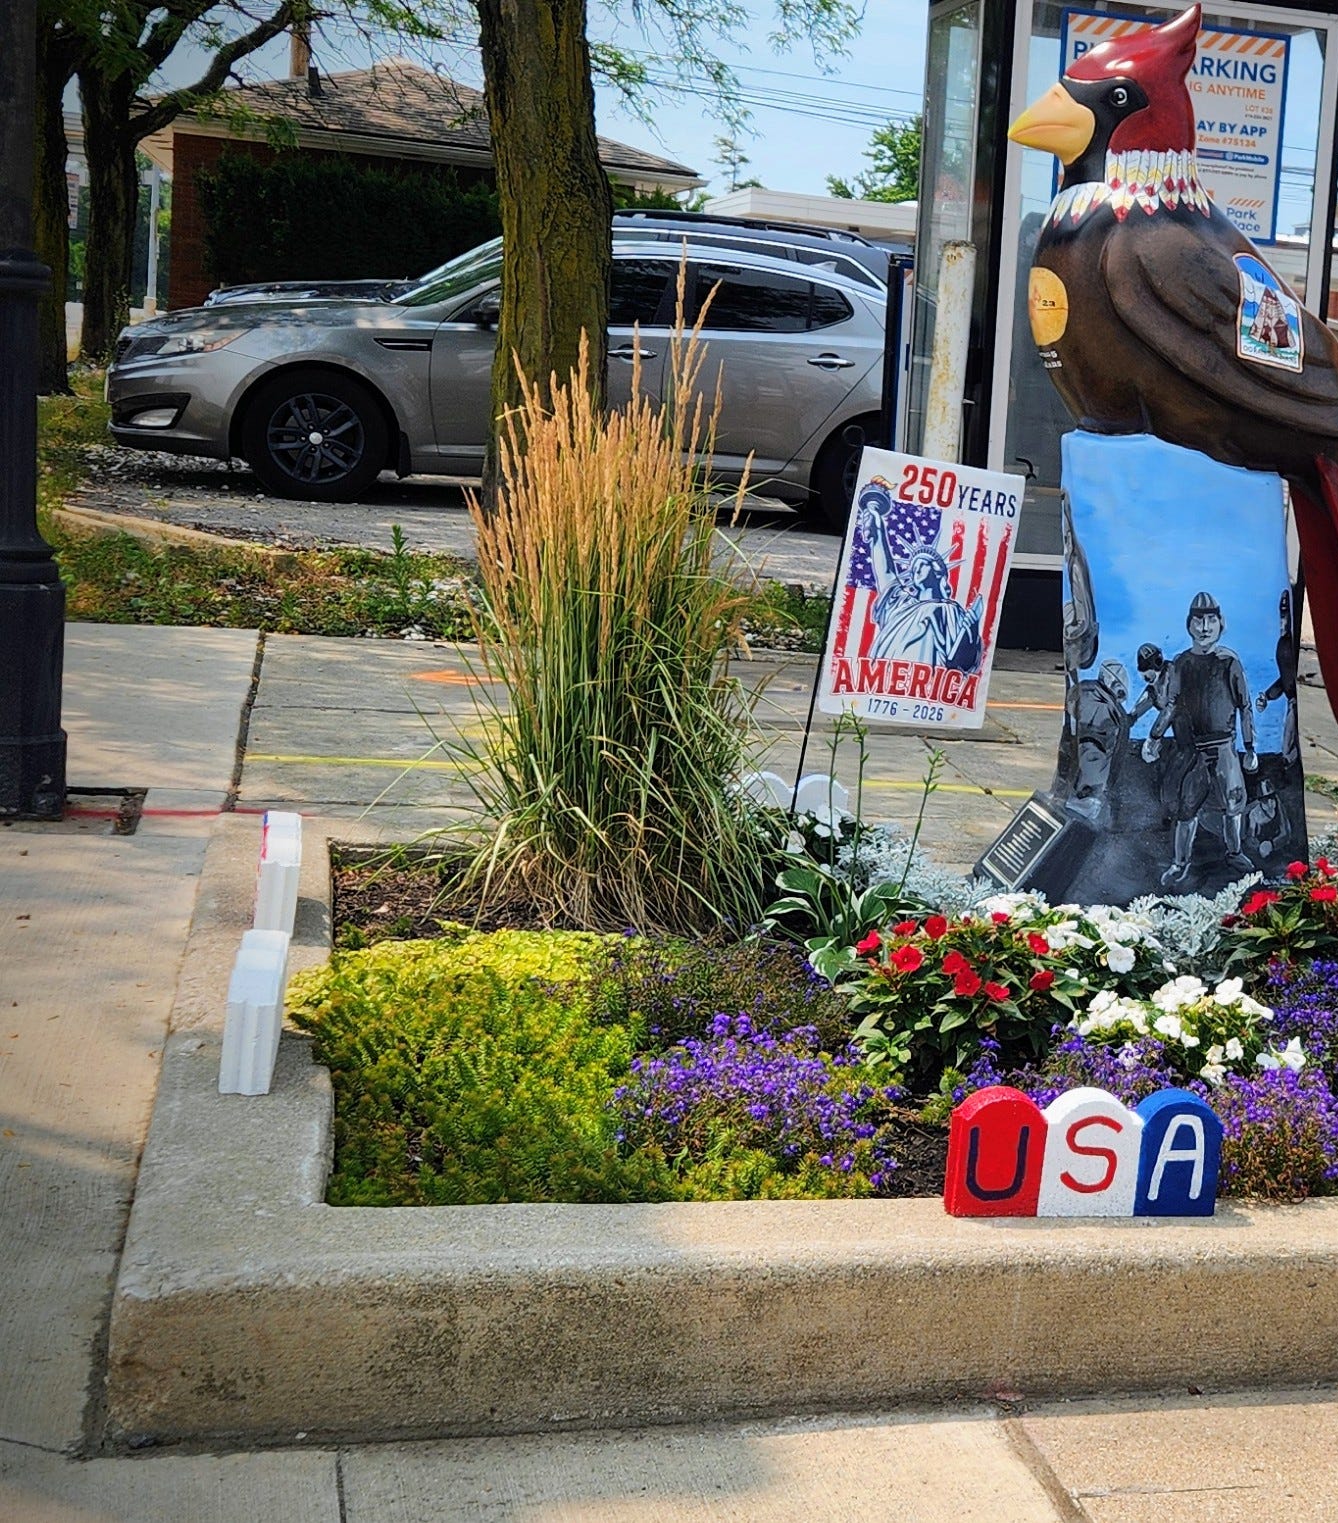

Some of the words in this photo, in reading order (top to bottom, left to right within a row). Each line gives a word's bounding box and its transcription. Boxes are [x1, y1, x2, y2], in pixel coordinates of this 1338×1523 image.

[1192, 56, 1276, 84] RKING
[1207, 84, 1266, 100] ANYTIME
[1197, 120, 1215, 132] AY
[1219, 122, 1237, 134] BY
[1240, 125, 1267, 137] APP
[1226, 207, 1257, 220] Park
[1234, 220, 1260, 232] ace
[899, 464, 957, 509] 250
[958, 485, 1017, 518] YEARS
[831, 657, 982, 712] AMERICA
[867, 697, 897, 716] 1776
[912, 703, 944, 722] 2026
[965, 1114, 1205, 1202] USA
